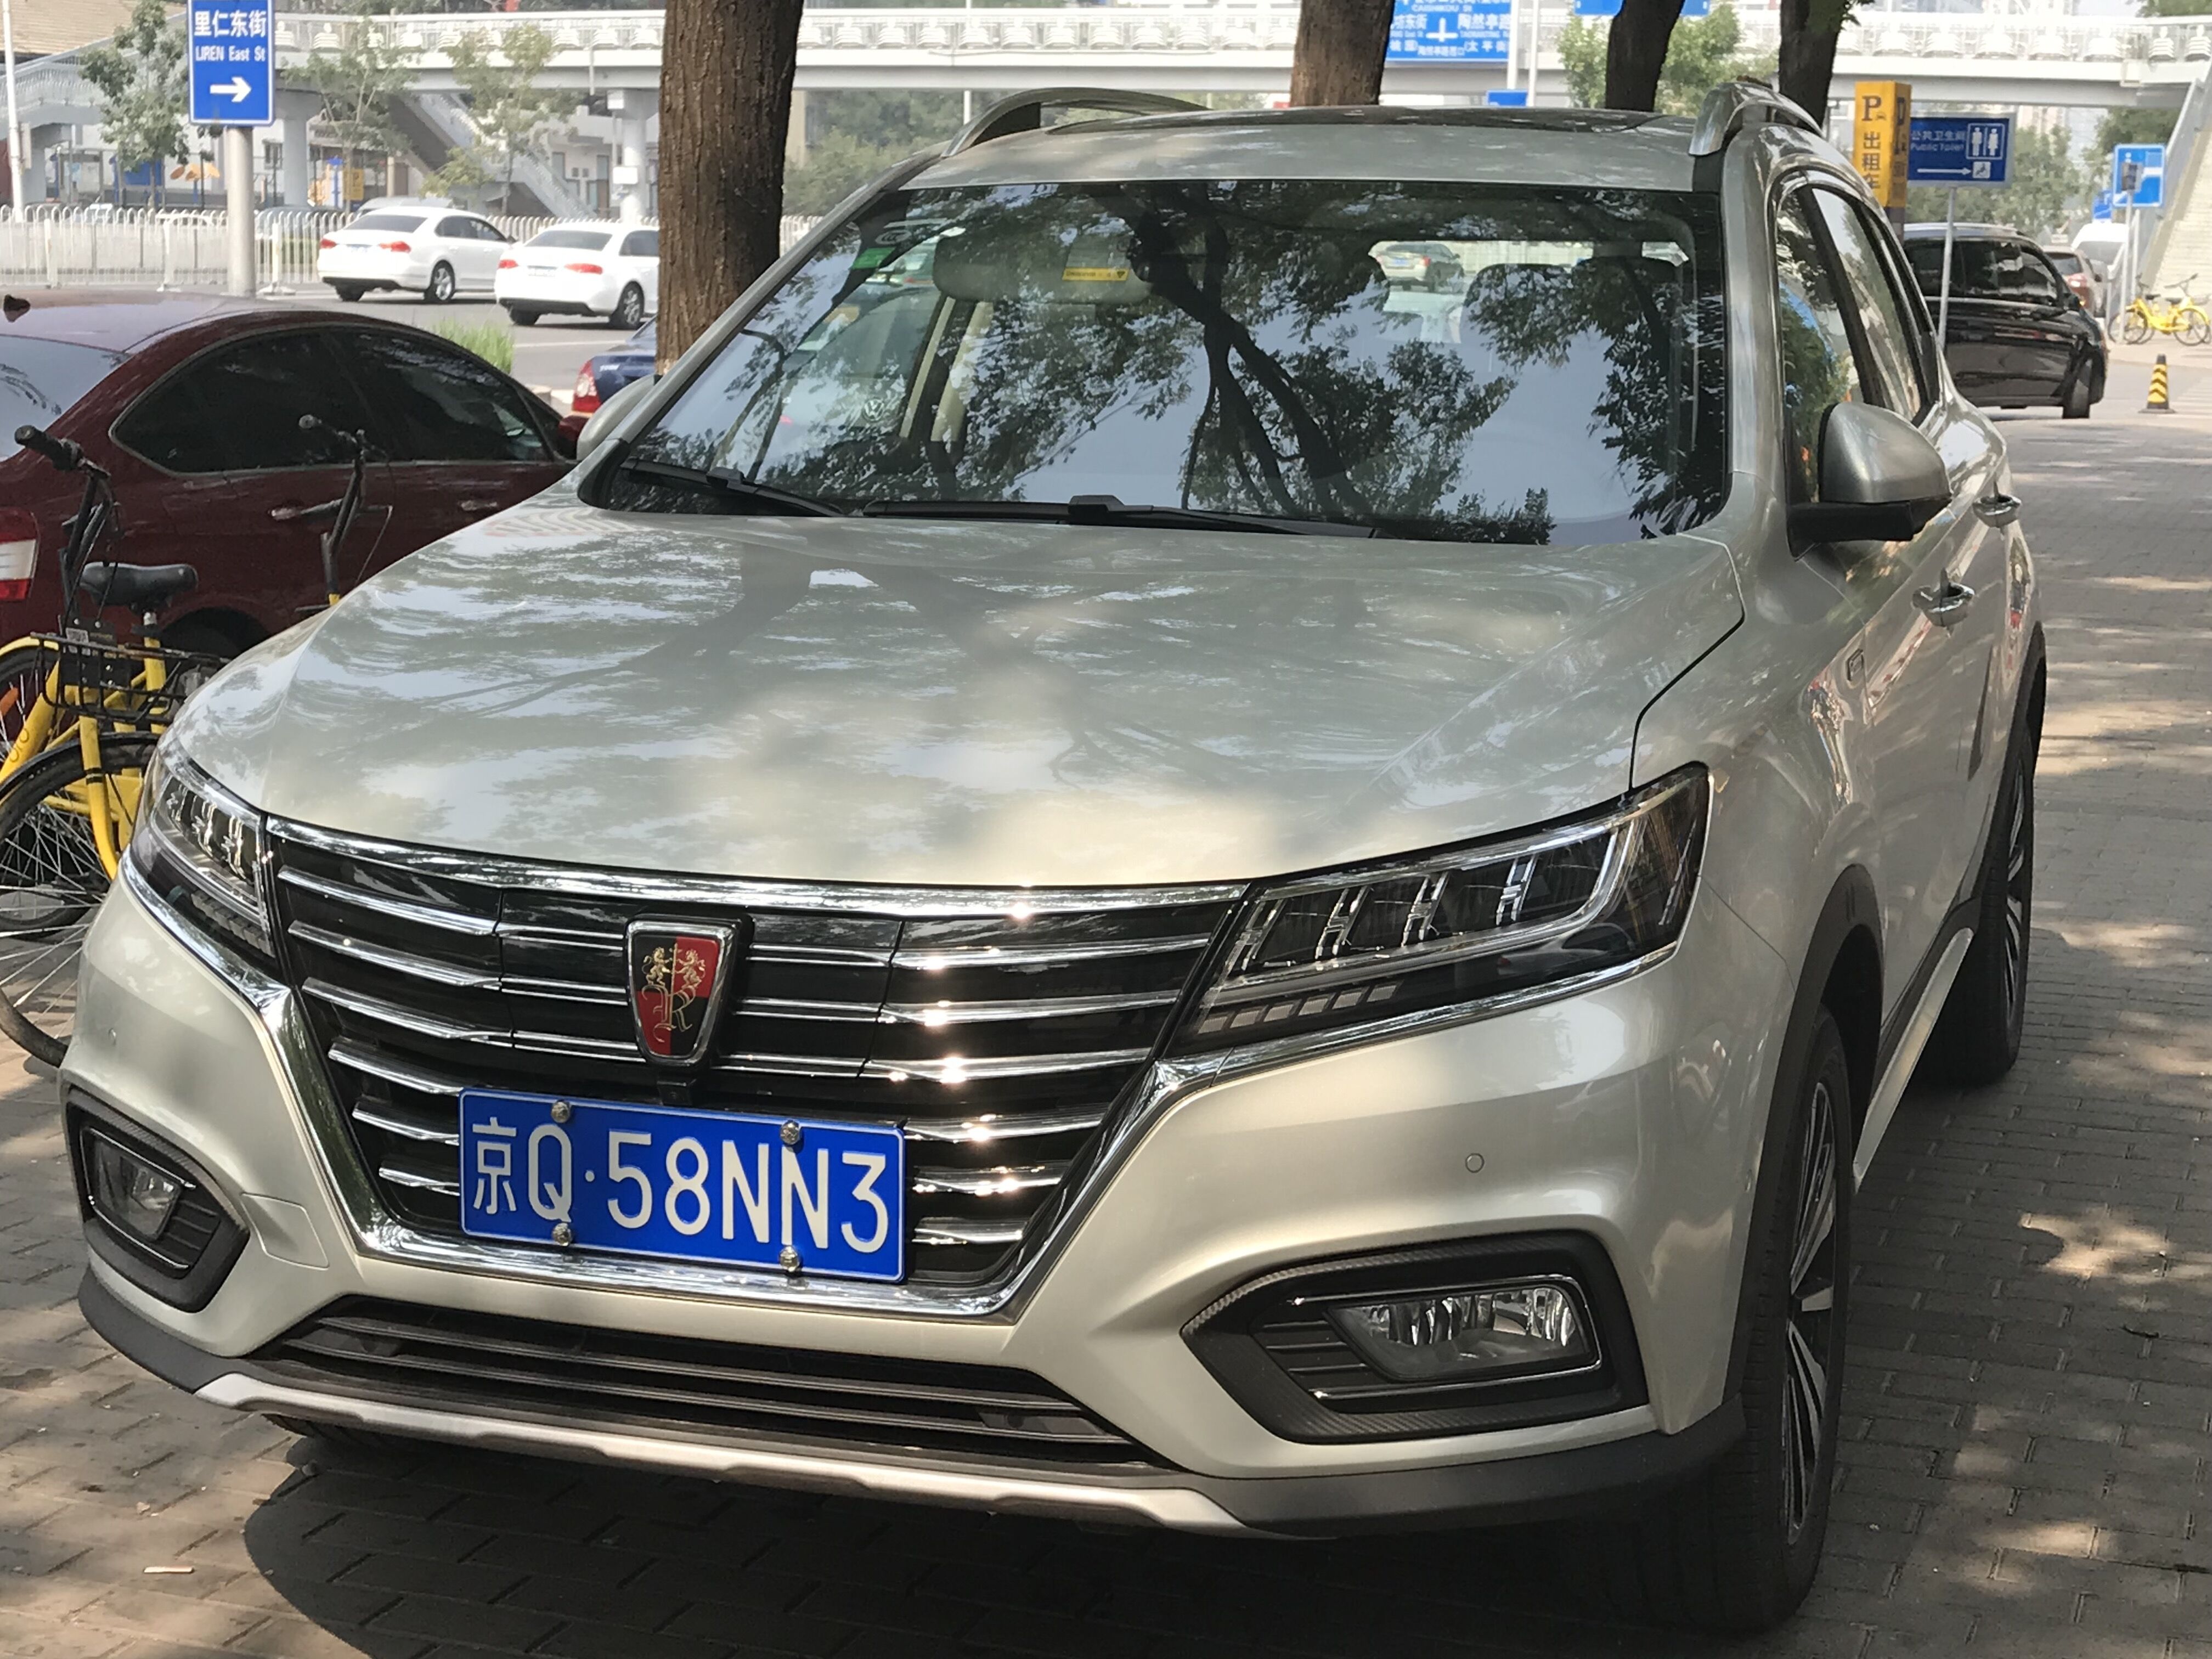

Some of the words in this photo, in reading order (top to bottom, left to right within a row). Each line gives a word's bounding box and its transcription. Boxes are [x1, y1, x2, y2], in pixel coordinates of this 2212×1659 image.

[194, 9, 267, 37] 里仁东街
[195, 46, 224, 61] LIREN
[229, 46, 250, 61] East
[254, 46, 266, 61] St
[1861, 95, 1881, 121] P
[472, 1116, 889, 1254] 京Q·58NN3
